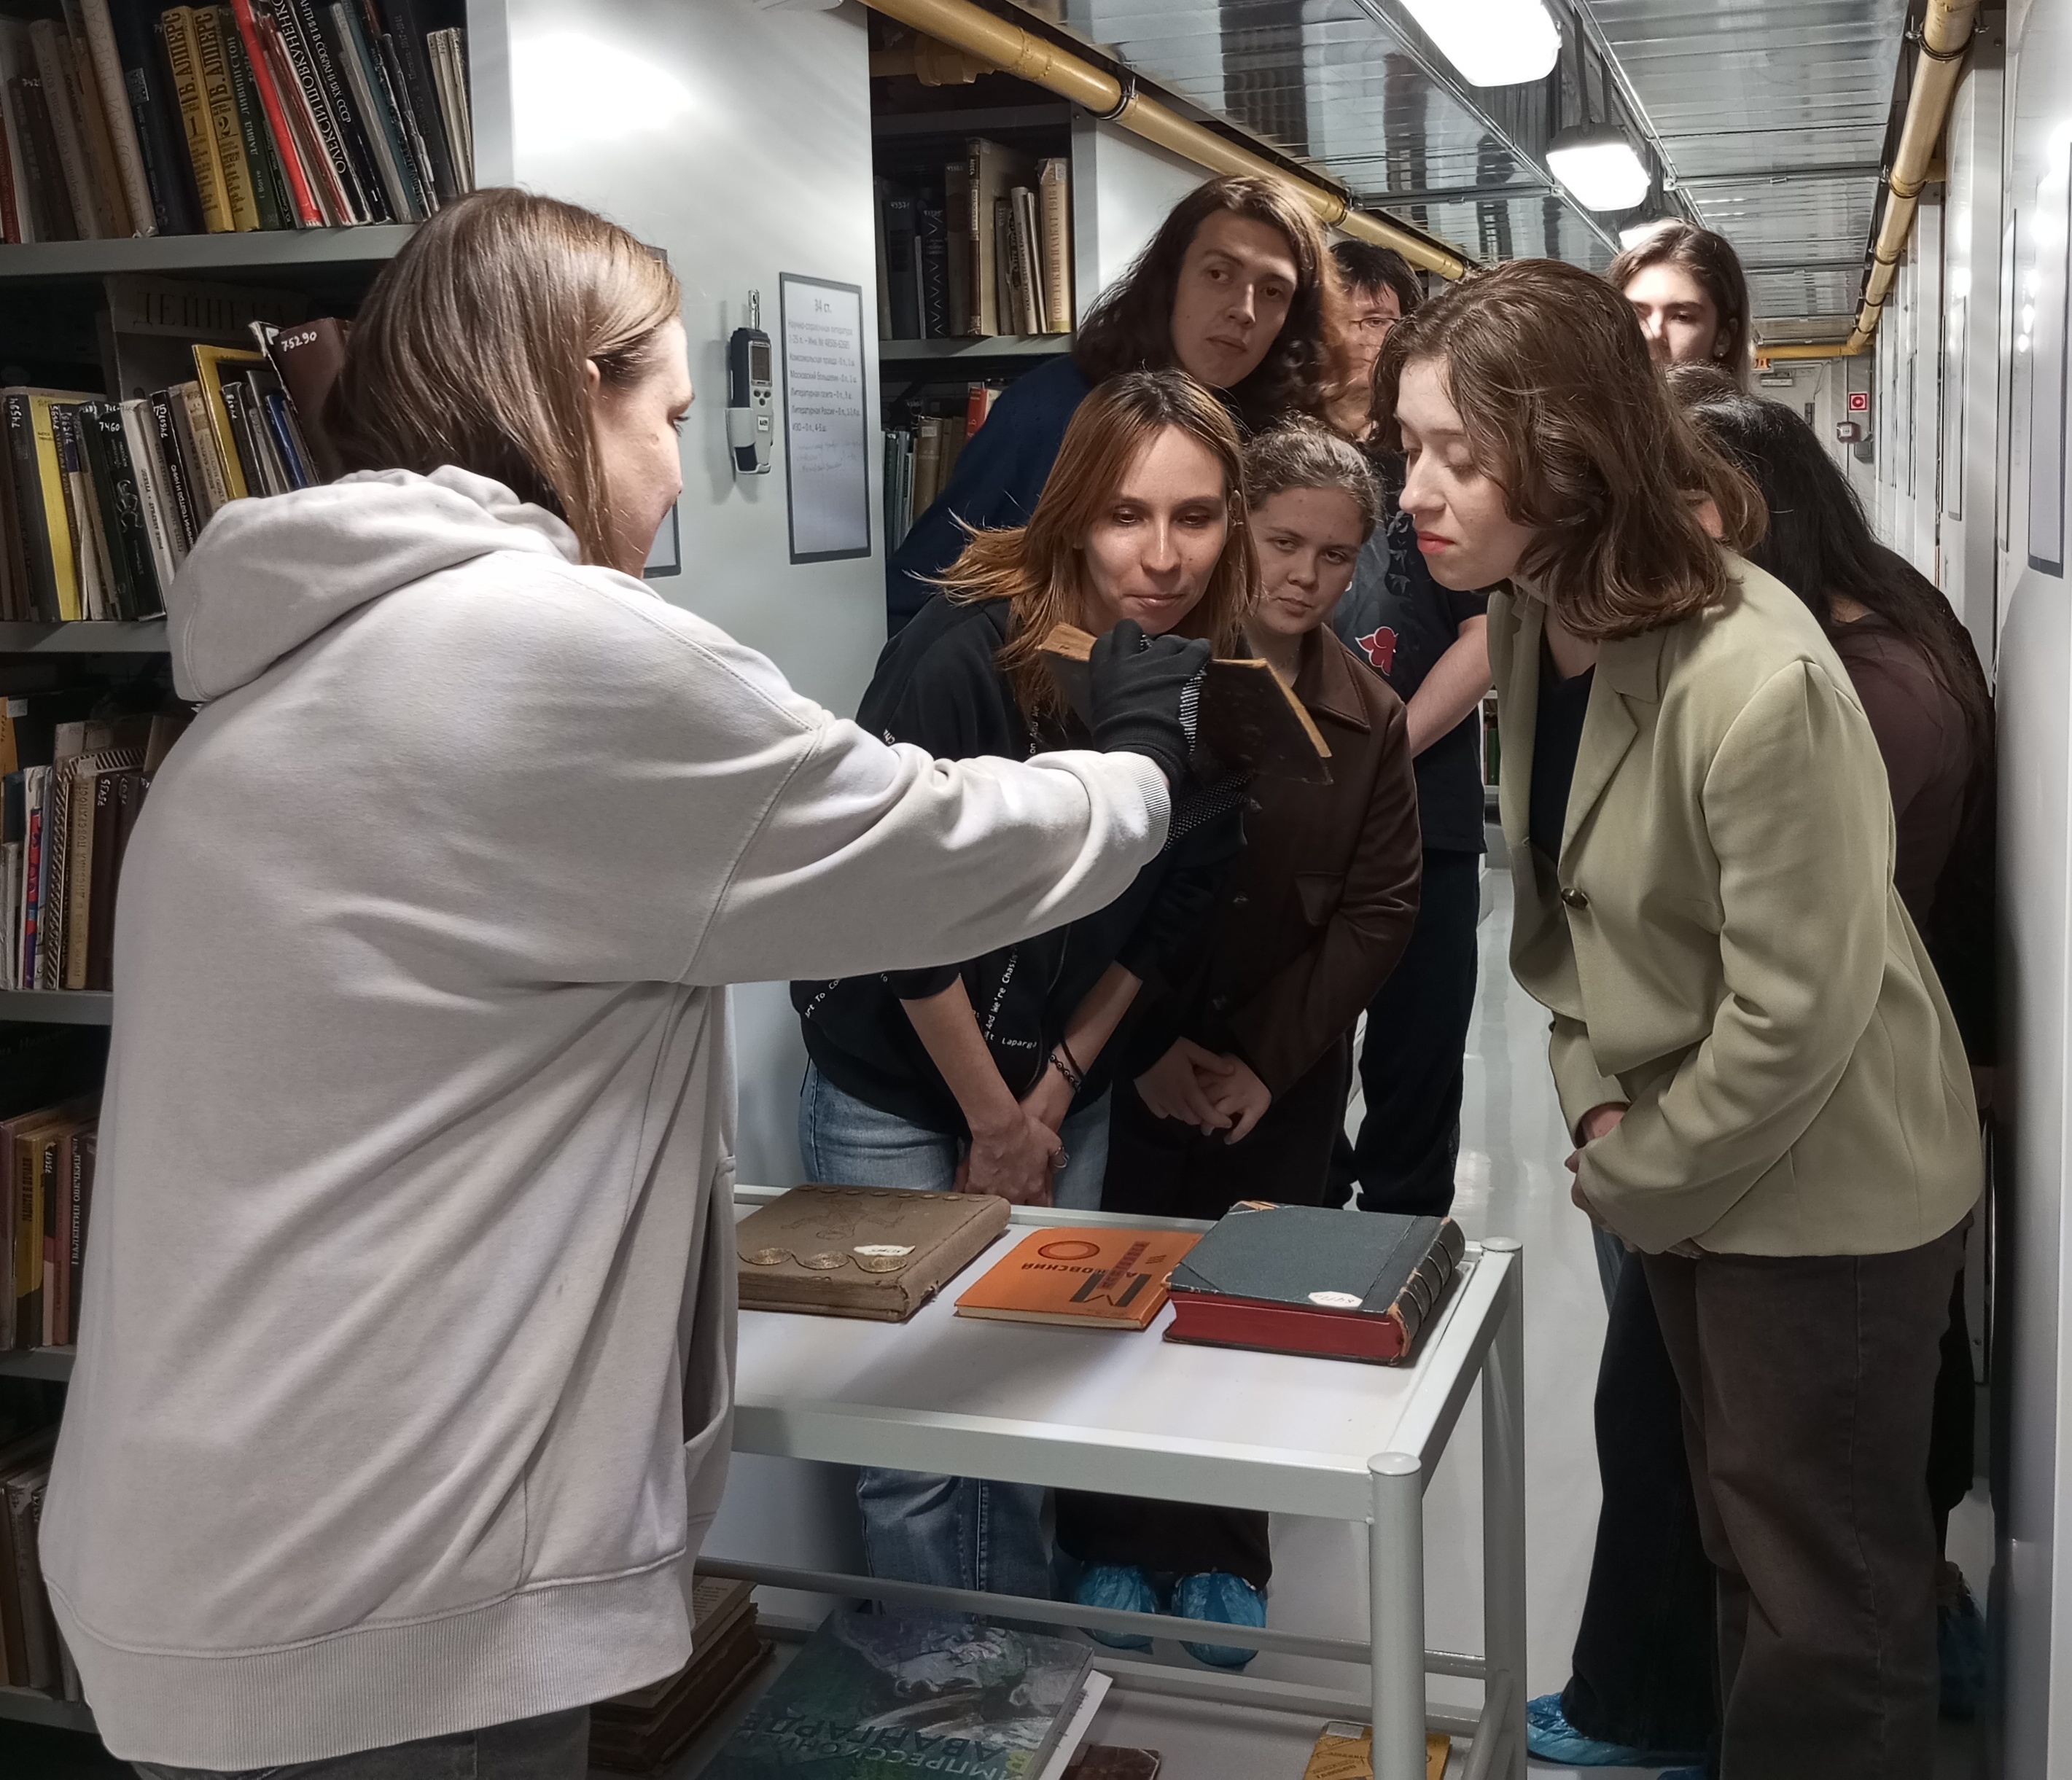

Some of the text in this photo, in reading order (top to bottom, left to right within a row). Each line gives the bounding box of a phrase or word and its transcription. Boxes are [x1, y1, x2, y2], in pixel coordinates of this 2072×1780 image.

[163, 12, 192, 77] АЛПЕРС
[193, 13, 225, 77] АЛПЕРС
[227, 36, 251, 115] ЛИВИНГСТОН
[314, 40, 342, 98] СОБРАНИЯХ
[336, 99, 351, 124] СССР
[188, 116, 200, 137] 1
[219, 116, 232, 134] 2
[244, 120, 259, 156] ДАВИД
[313, 104, 347, 174] ОЛЕКСІЙ
[814, 298, 822, 312] 34
[281, 331, 317, 351] 75290
[9, 398, 22, 429] 74594
[99, 422, 120, 432] 7460
[815, 992, 825, 1003] To
[829, 979, 839, 990] Co
[986, 1015, 996, 1030] And
[72, 1205, 80, 1258] ВАЛЕНТИН
[739, 1711, 1006, 1763] АВАНГАРДЕ
